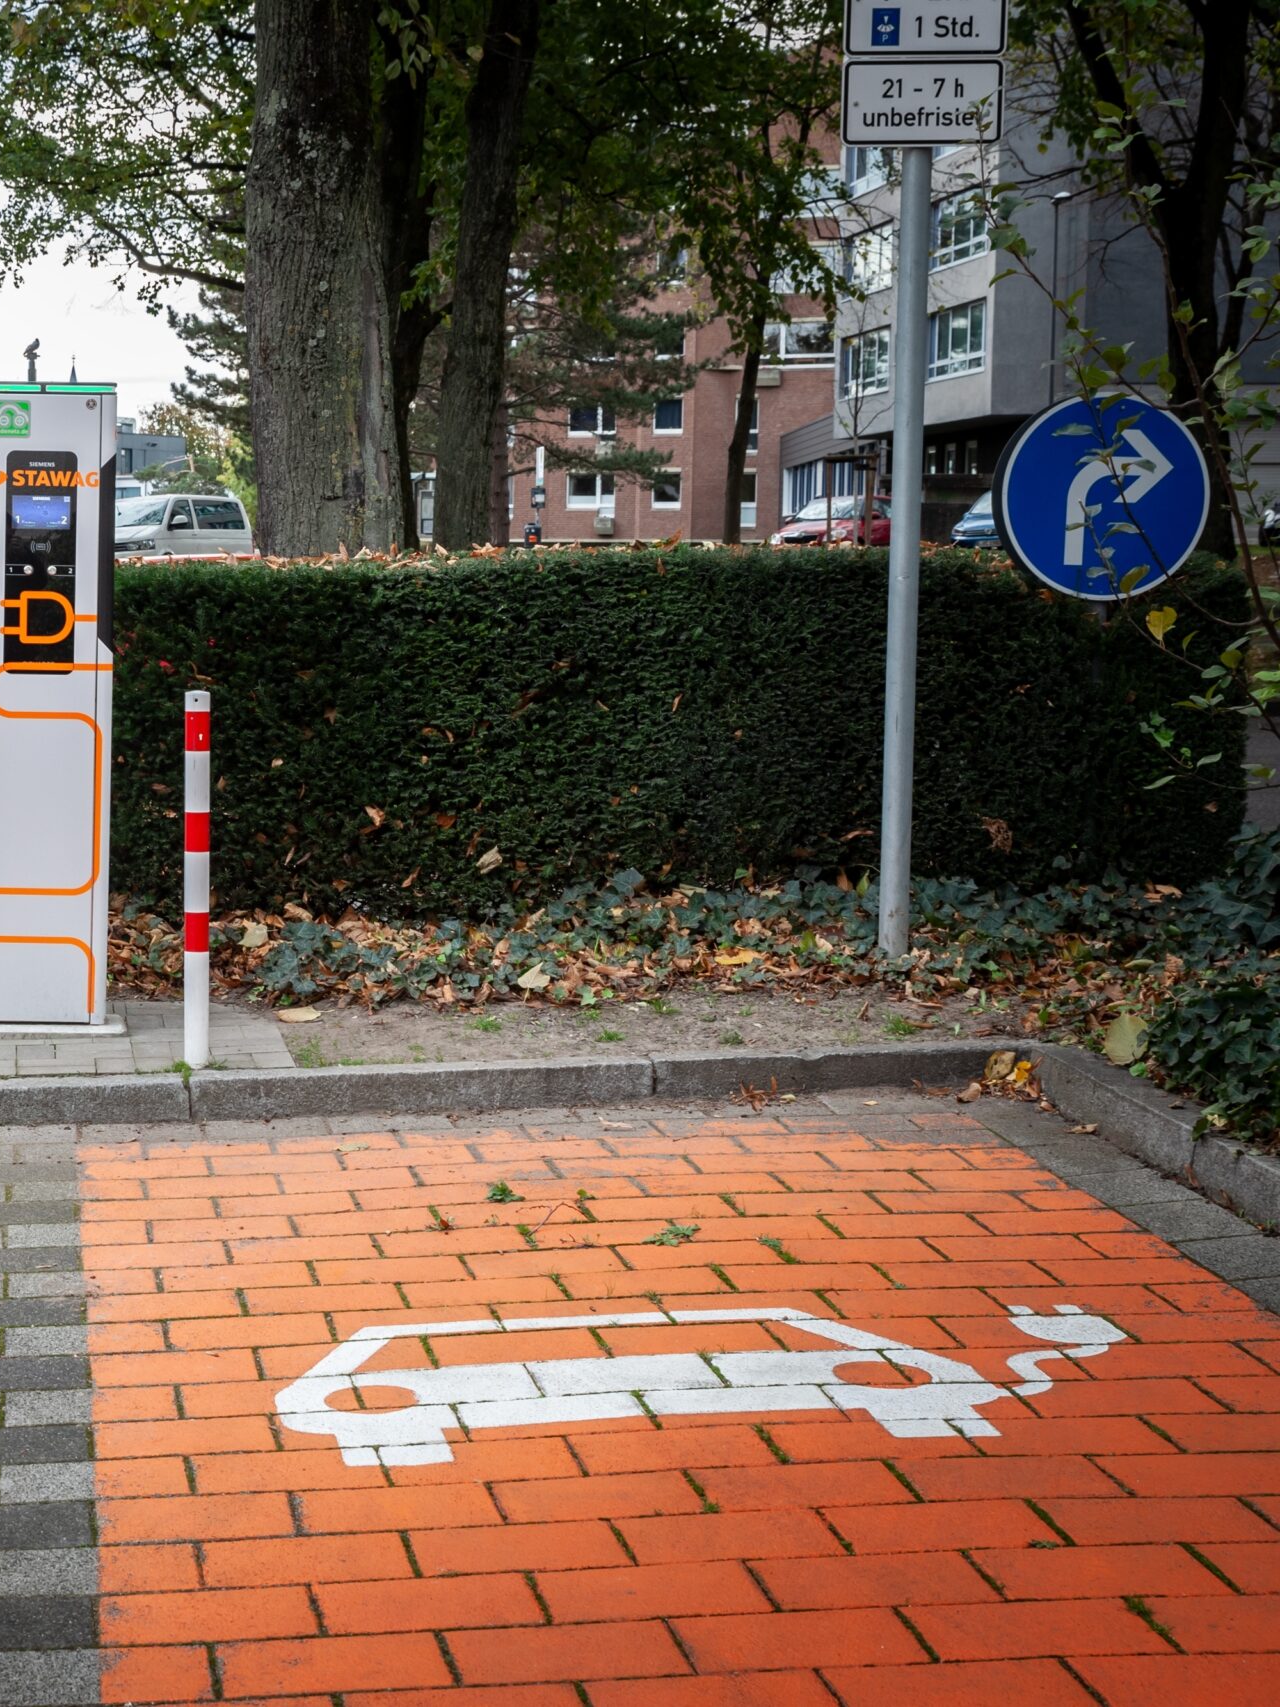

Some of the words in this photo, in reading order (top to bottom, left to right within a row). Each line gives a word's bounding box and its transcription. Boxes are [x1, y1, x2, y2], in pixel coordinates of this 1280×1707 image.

[915, 16, 923, 38] 1
[933, 15, 980, 38] Std.
[881, 78, 903, 99] 21
[933, 78, 946, 99] 7
[954, 77, 964, 98] h
[862, 106, 982, 127] unbefriste
[12, 469, 100, 488] STAWAG
[15, 515, 20, 524] 1
[61, 515, 68, 525] 2
